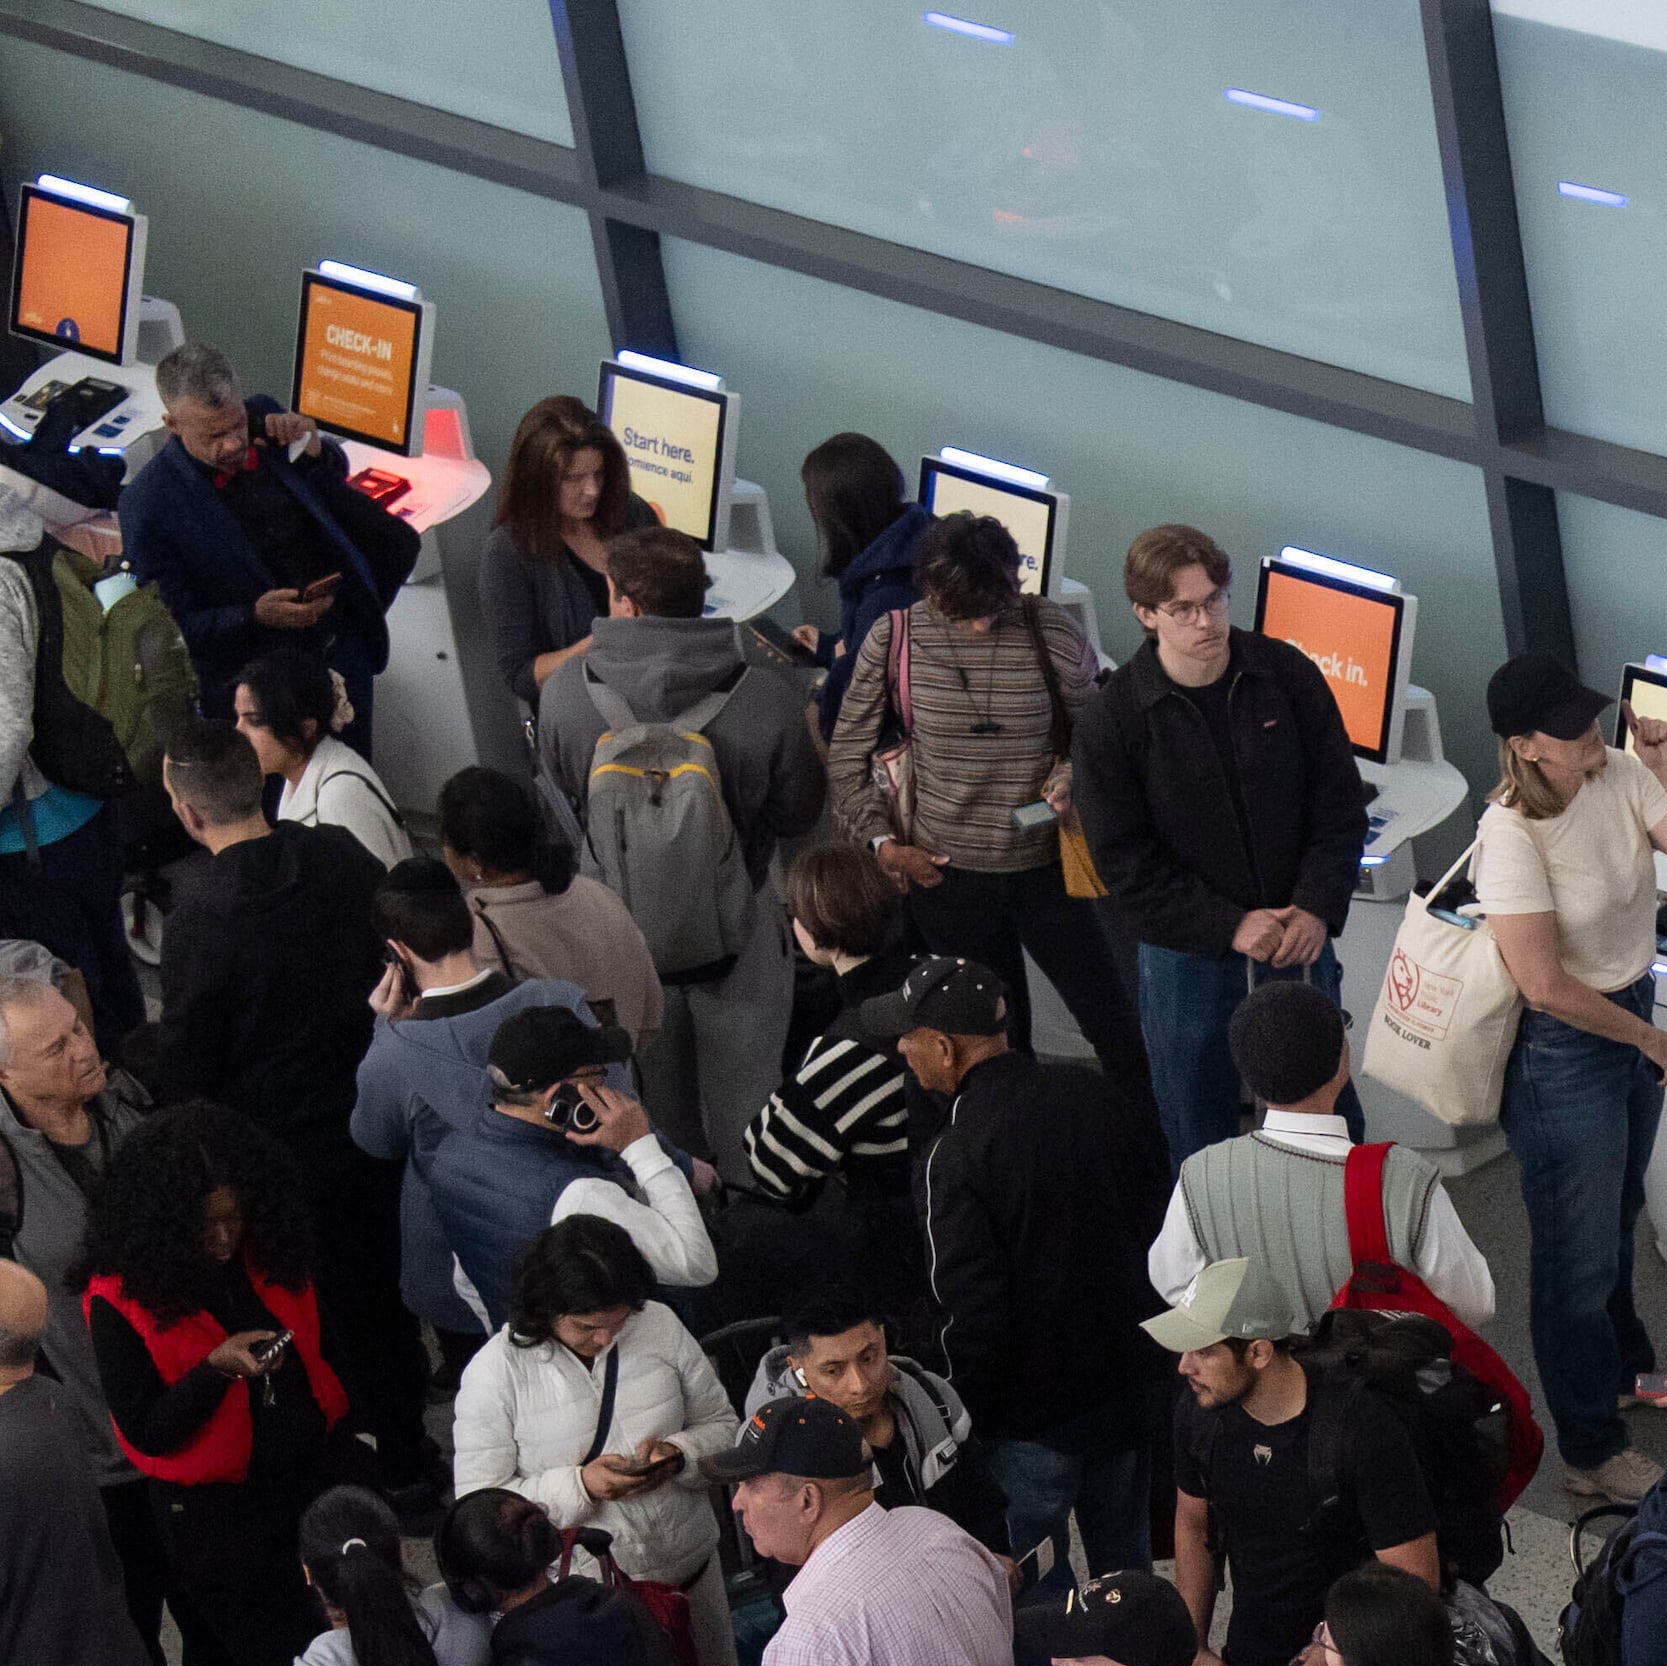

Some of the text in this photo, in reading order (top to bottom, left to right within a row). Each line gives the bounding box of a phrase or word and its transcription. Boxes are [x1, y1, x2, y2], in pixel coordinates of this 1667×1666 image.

[326, 324, 392, 361] CHECK-IN
[624, 427, 695, 464] Start here.
[628, 457, 668, 477] omience
[1018, 554, 1038, 570] re.
[1345, 658, 1369, 687] in.
[1417, 998, 1443, 1017] Library
[1402, 1028, 1432, 1051] LOVER
